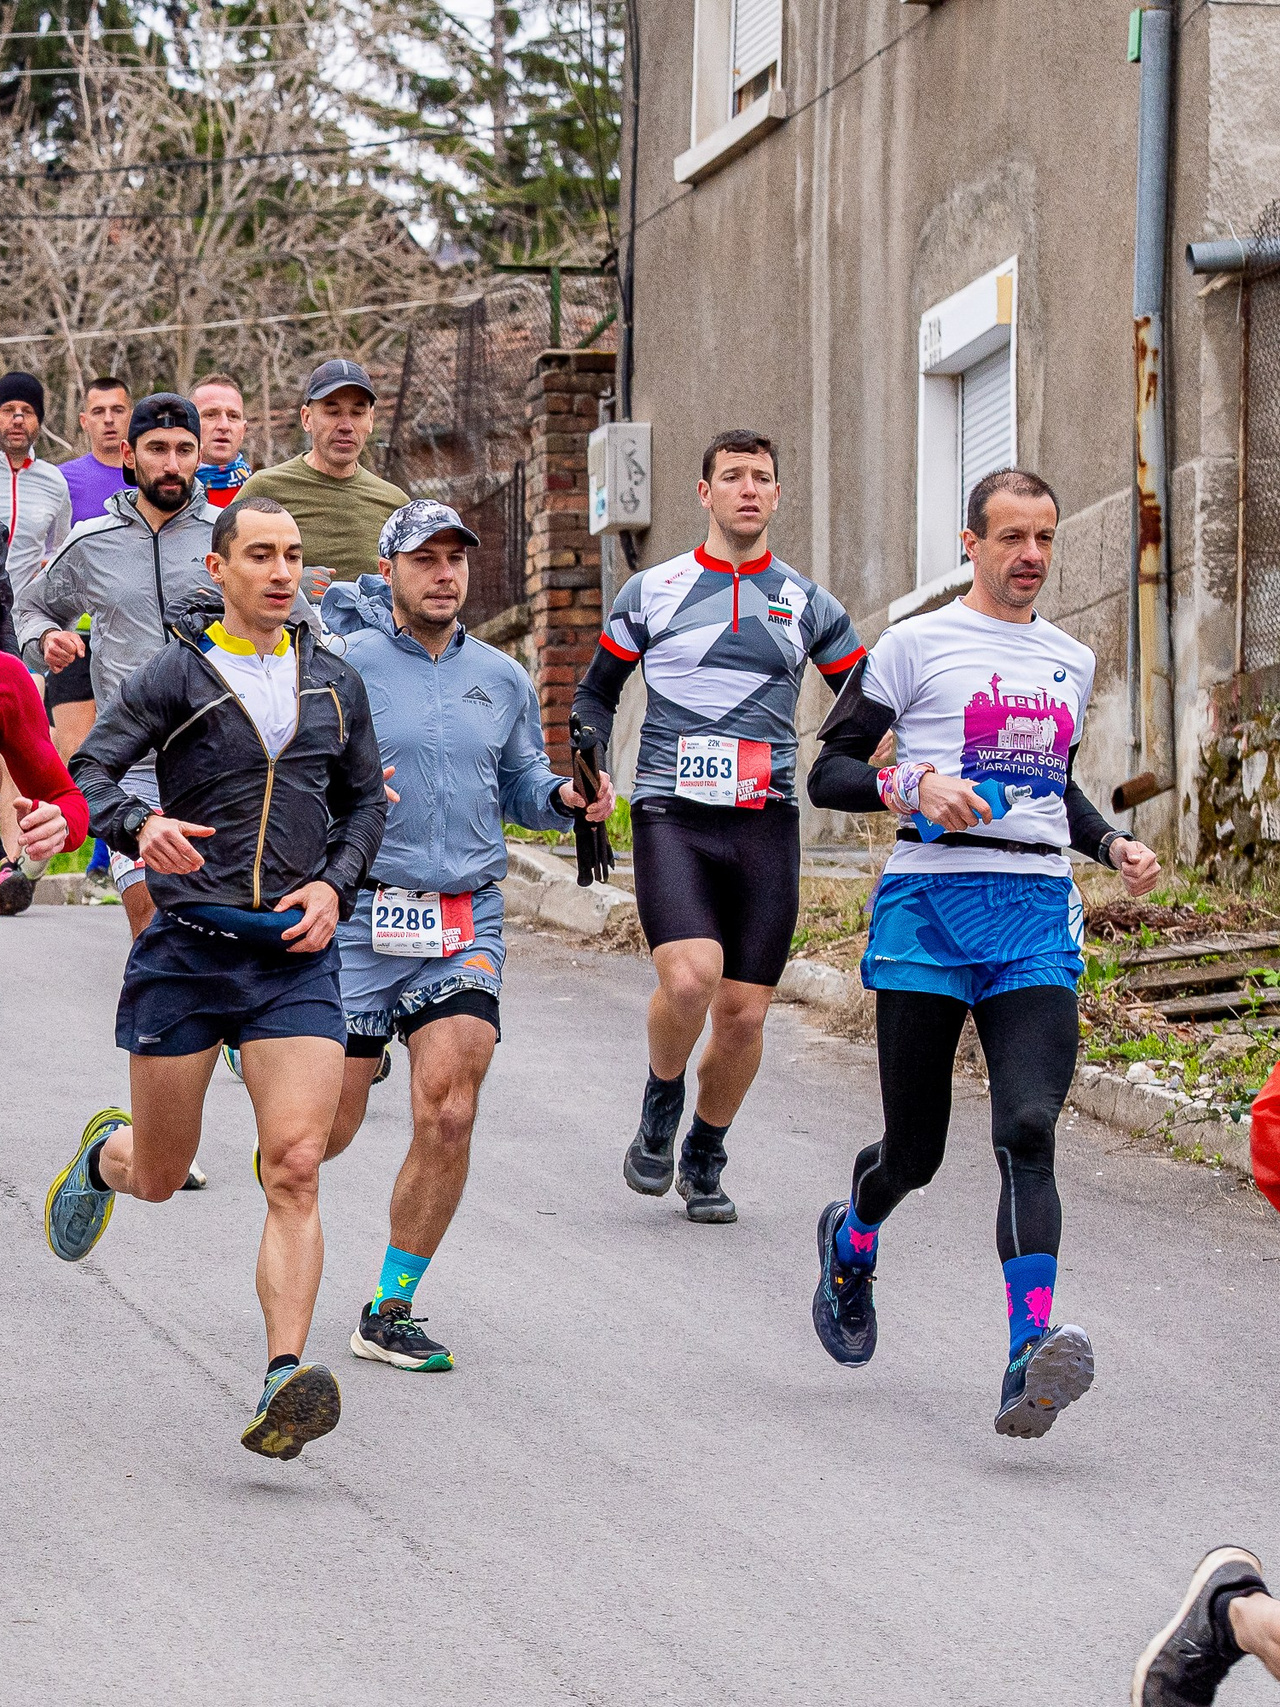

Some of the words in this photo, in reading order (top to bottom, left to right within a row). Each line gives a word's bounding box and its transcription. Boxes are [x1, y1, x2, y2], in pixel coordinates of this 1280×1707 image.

[768, 593, 792, 607] BUL
[708, 739, 720, 747] 22K
[680, 756, 732, 779] 2363
[977, 749, 1012, 761] WIZZ
[1013, 752, 1035, 764] AIR
[1037, 755, 1066, 772] SOFIA
[976, 762, 1043, 777] MARATHON
[376, 906, 436, 930] 2286
[376, 931, 405, 939] MARKOVO
